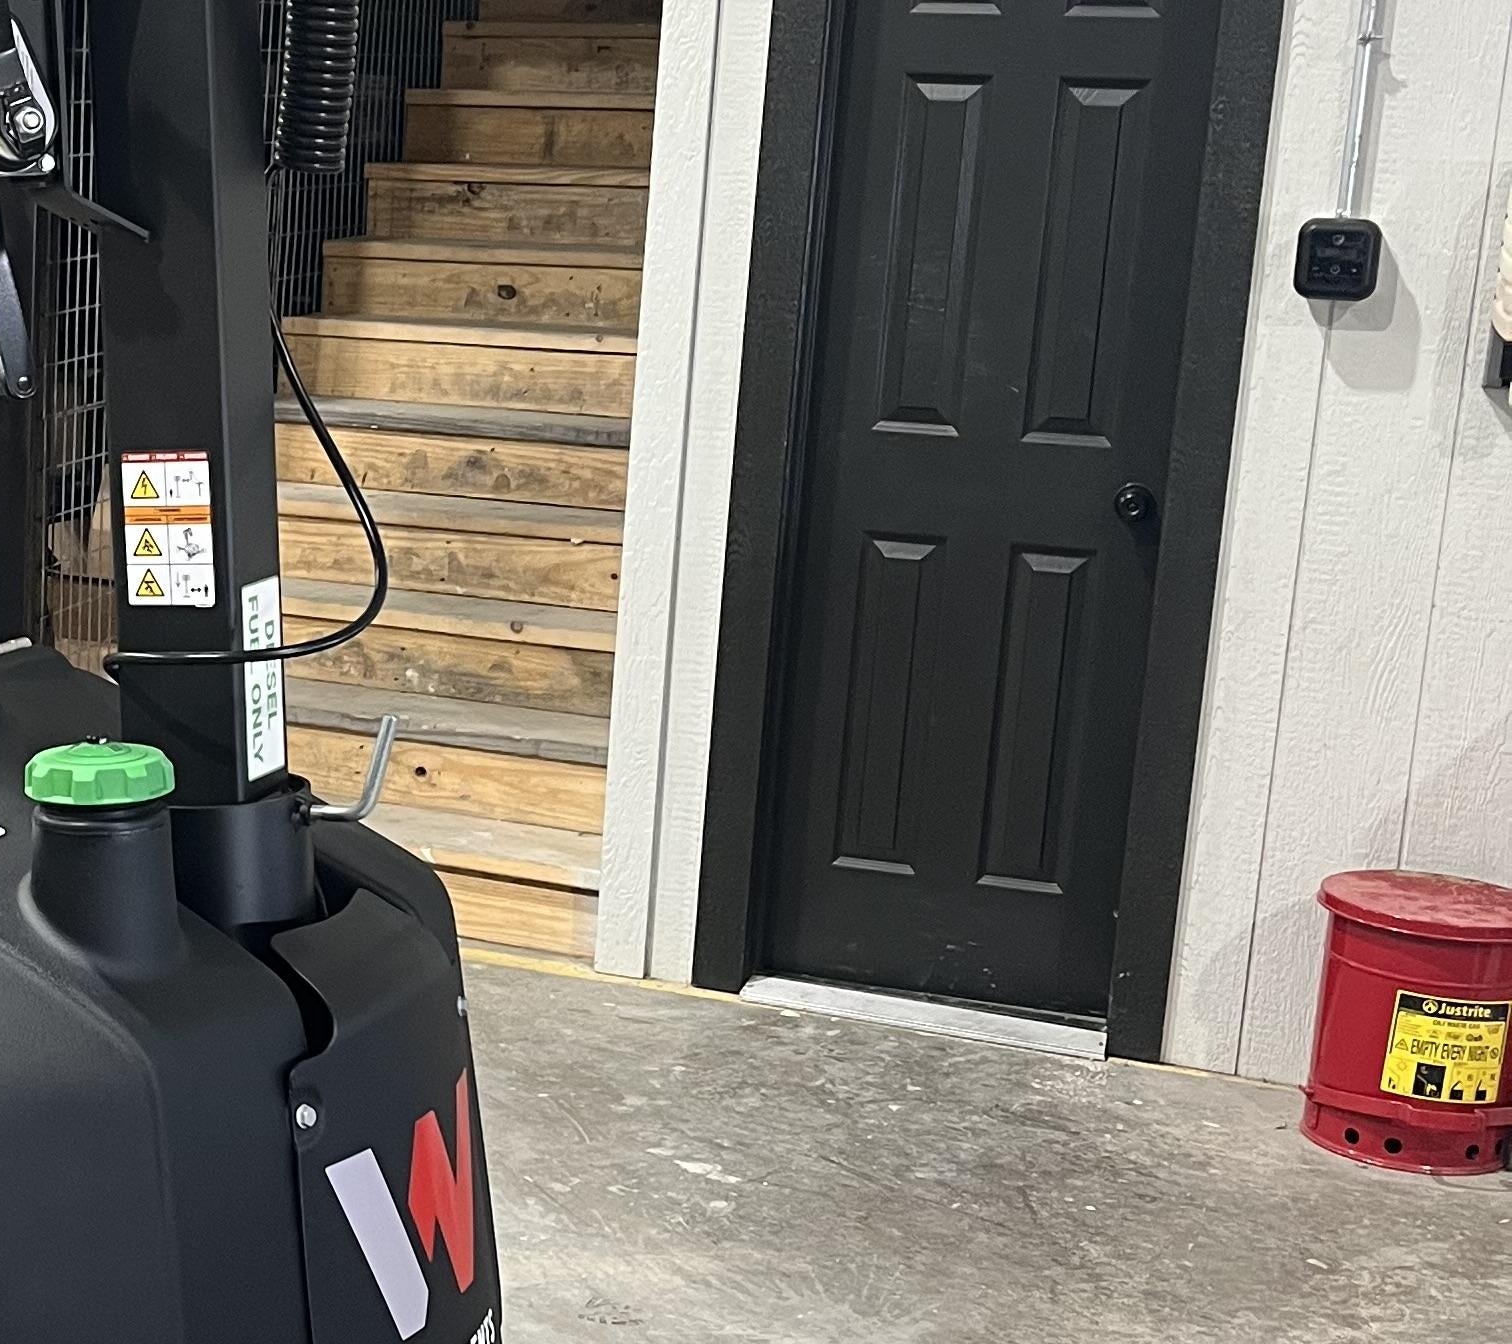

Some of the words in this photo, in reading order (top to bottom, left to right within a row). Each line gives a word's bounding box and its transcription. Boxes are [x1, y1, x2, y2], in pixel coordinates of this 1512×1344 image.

[251, 683, 264, 764] ONLY
[1437, 1002, 1492, 1018] Justrite
[1410, 1038, 1440, 1058] EMPTY
[1440, 1043, 1467, 1061] EVERY
